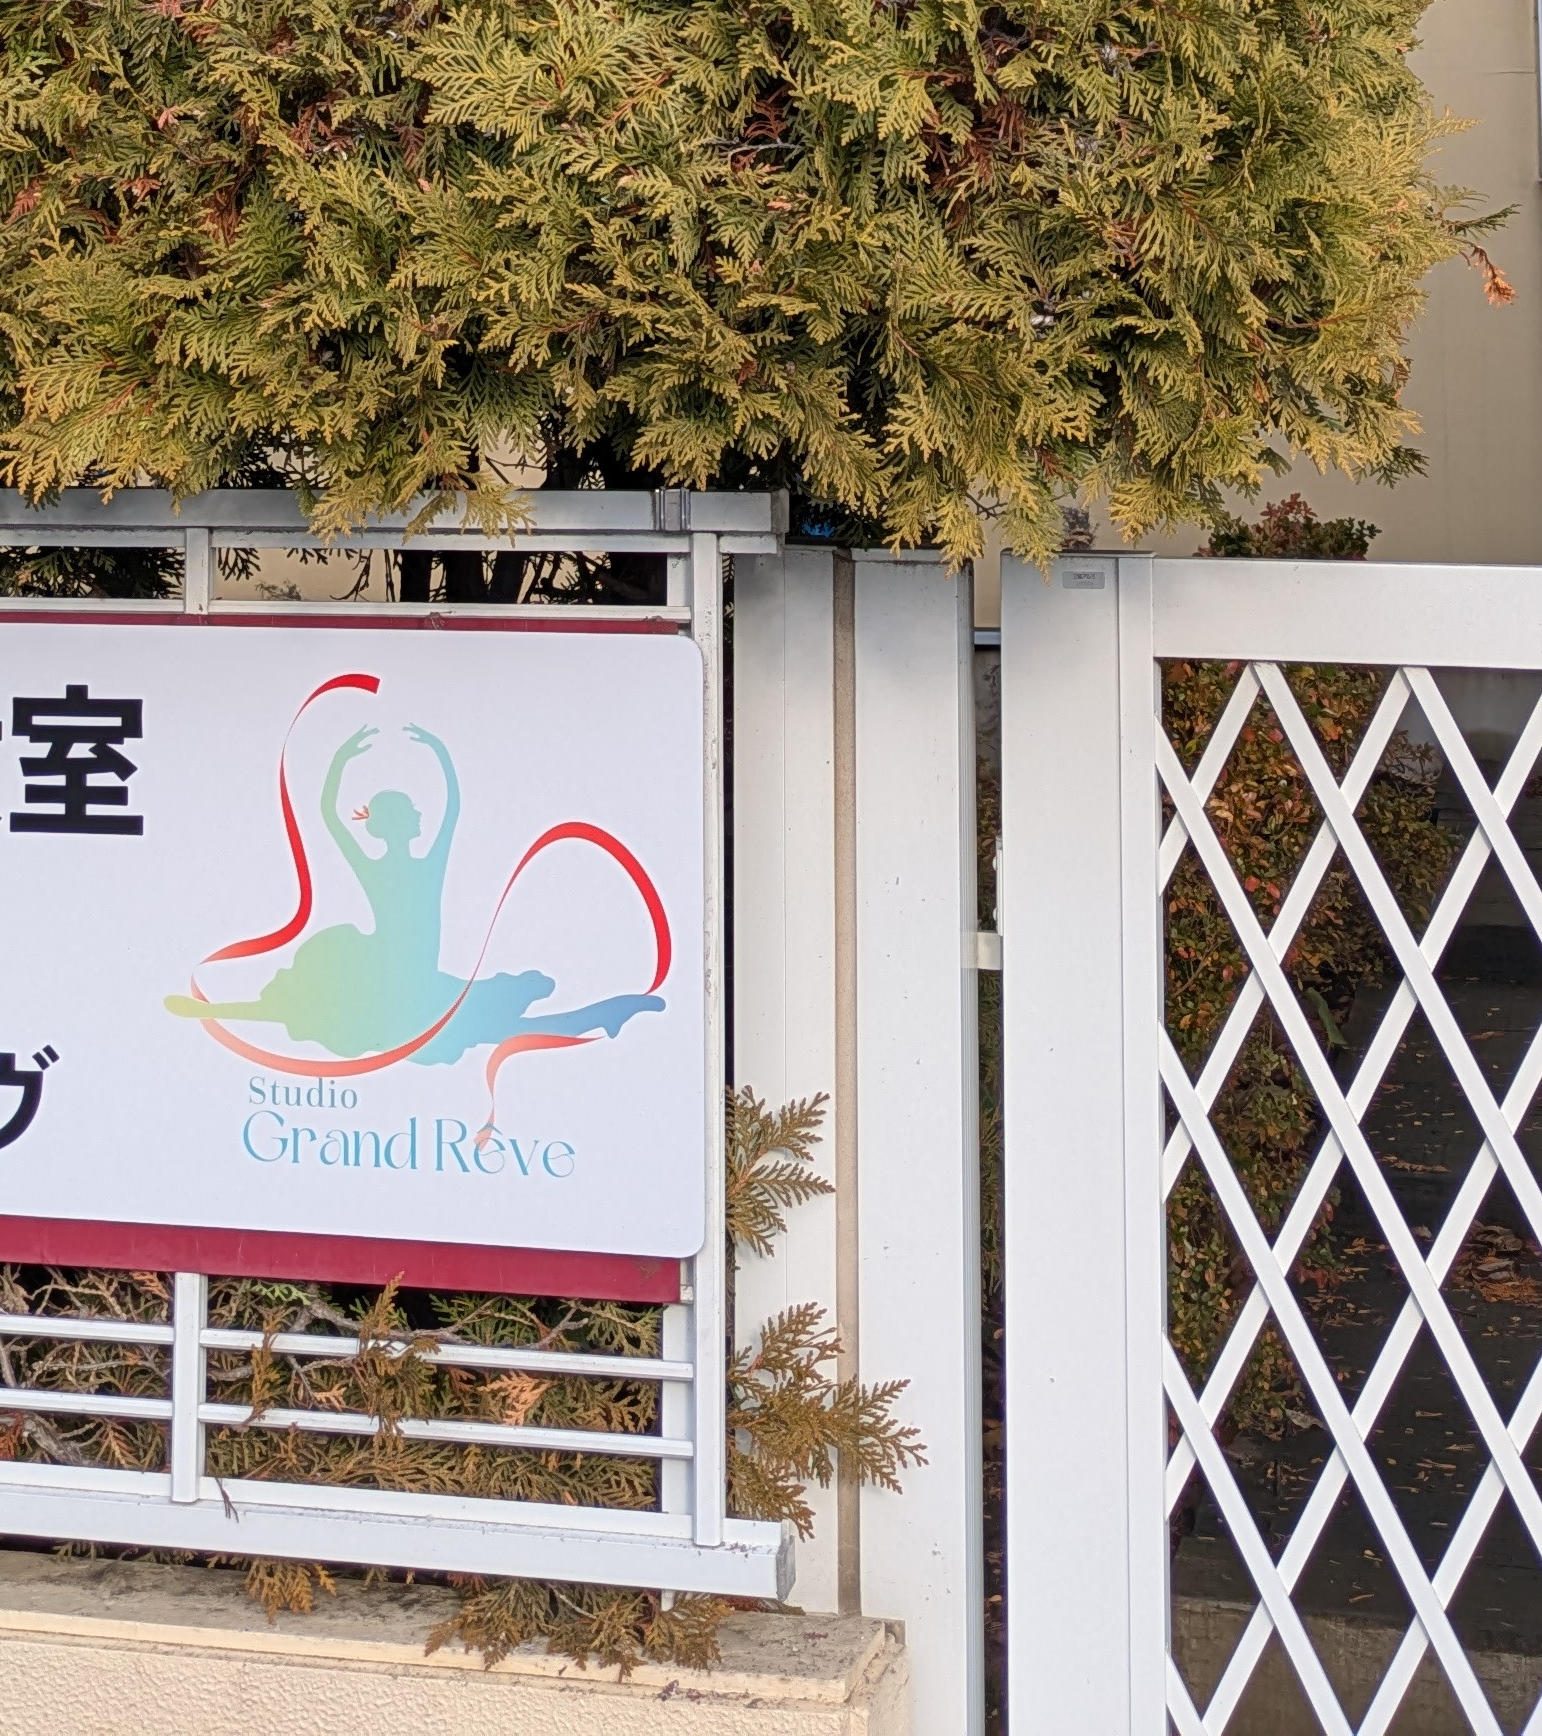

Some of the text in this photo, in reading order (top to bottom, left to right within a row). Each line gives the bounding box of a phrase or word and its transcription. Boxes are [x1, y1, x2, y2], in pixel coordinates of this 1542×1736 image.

[248, 1075, 358, 1110] Studio
[242, 1109, 576, 1178] Grand Rêve
